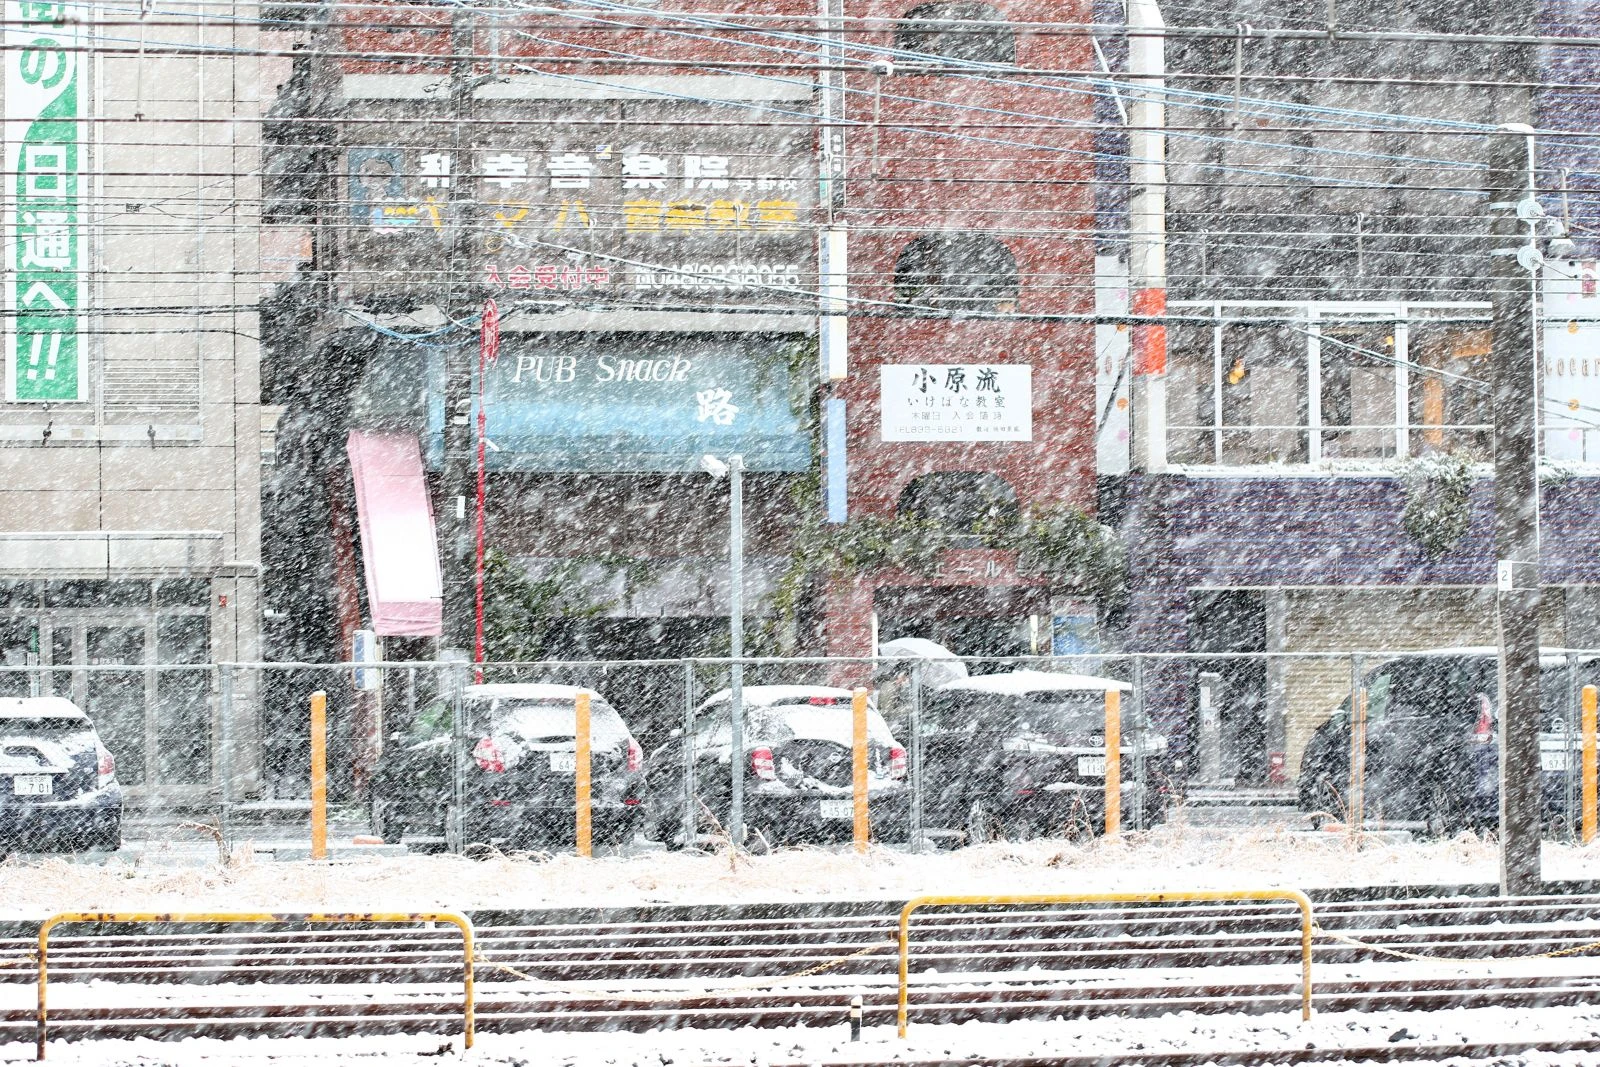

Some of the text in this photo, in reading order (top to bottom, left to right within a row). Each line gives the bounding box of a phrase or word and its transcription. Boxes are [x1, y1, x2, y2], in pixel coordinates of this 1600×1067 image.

[485, 264, 610, 290] 入会受付中
[512, 354, 692, 383] PUB Snack
[911, 366, 1001, 394] 小原流
[696, 387, 740, 426] 路
[907, 395, 1006, 408] いけばな教室
[1501, 569, 1508, 582] 2
